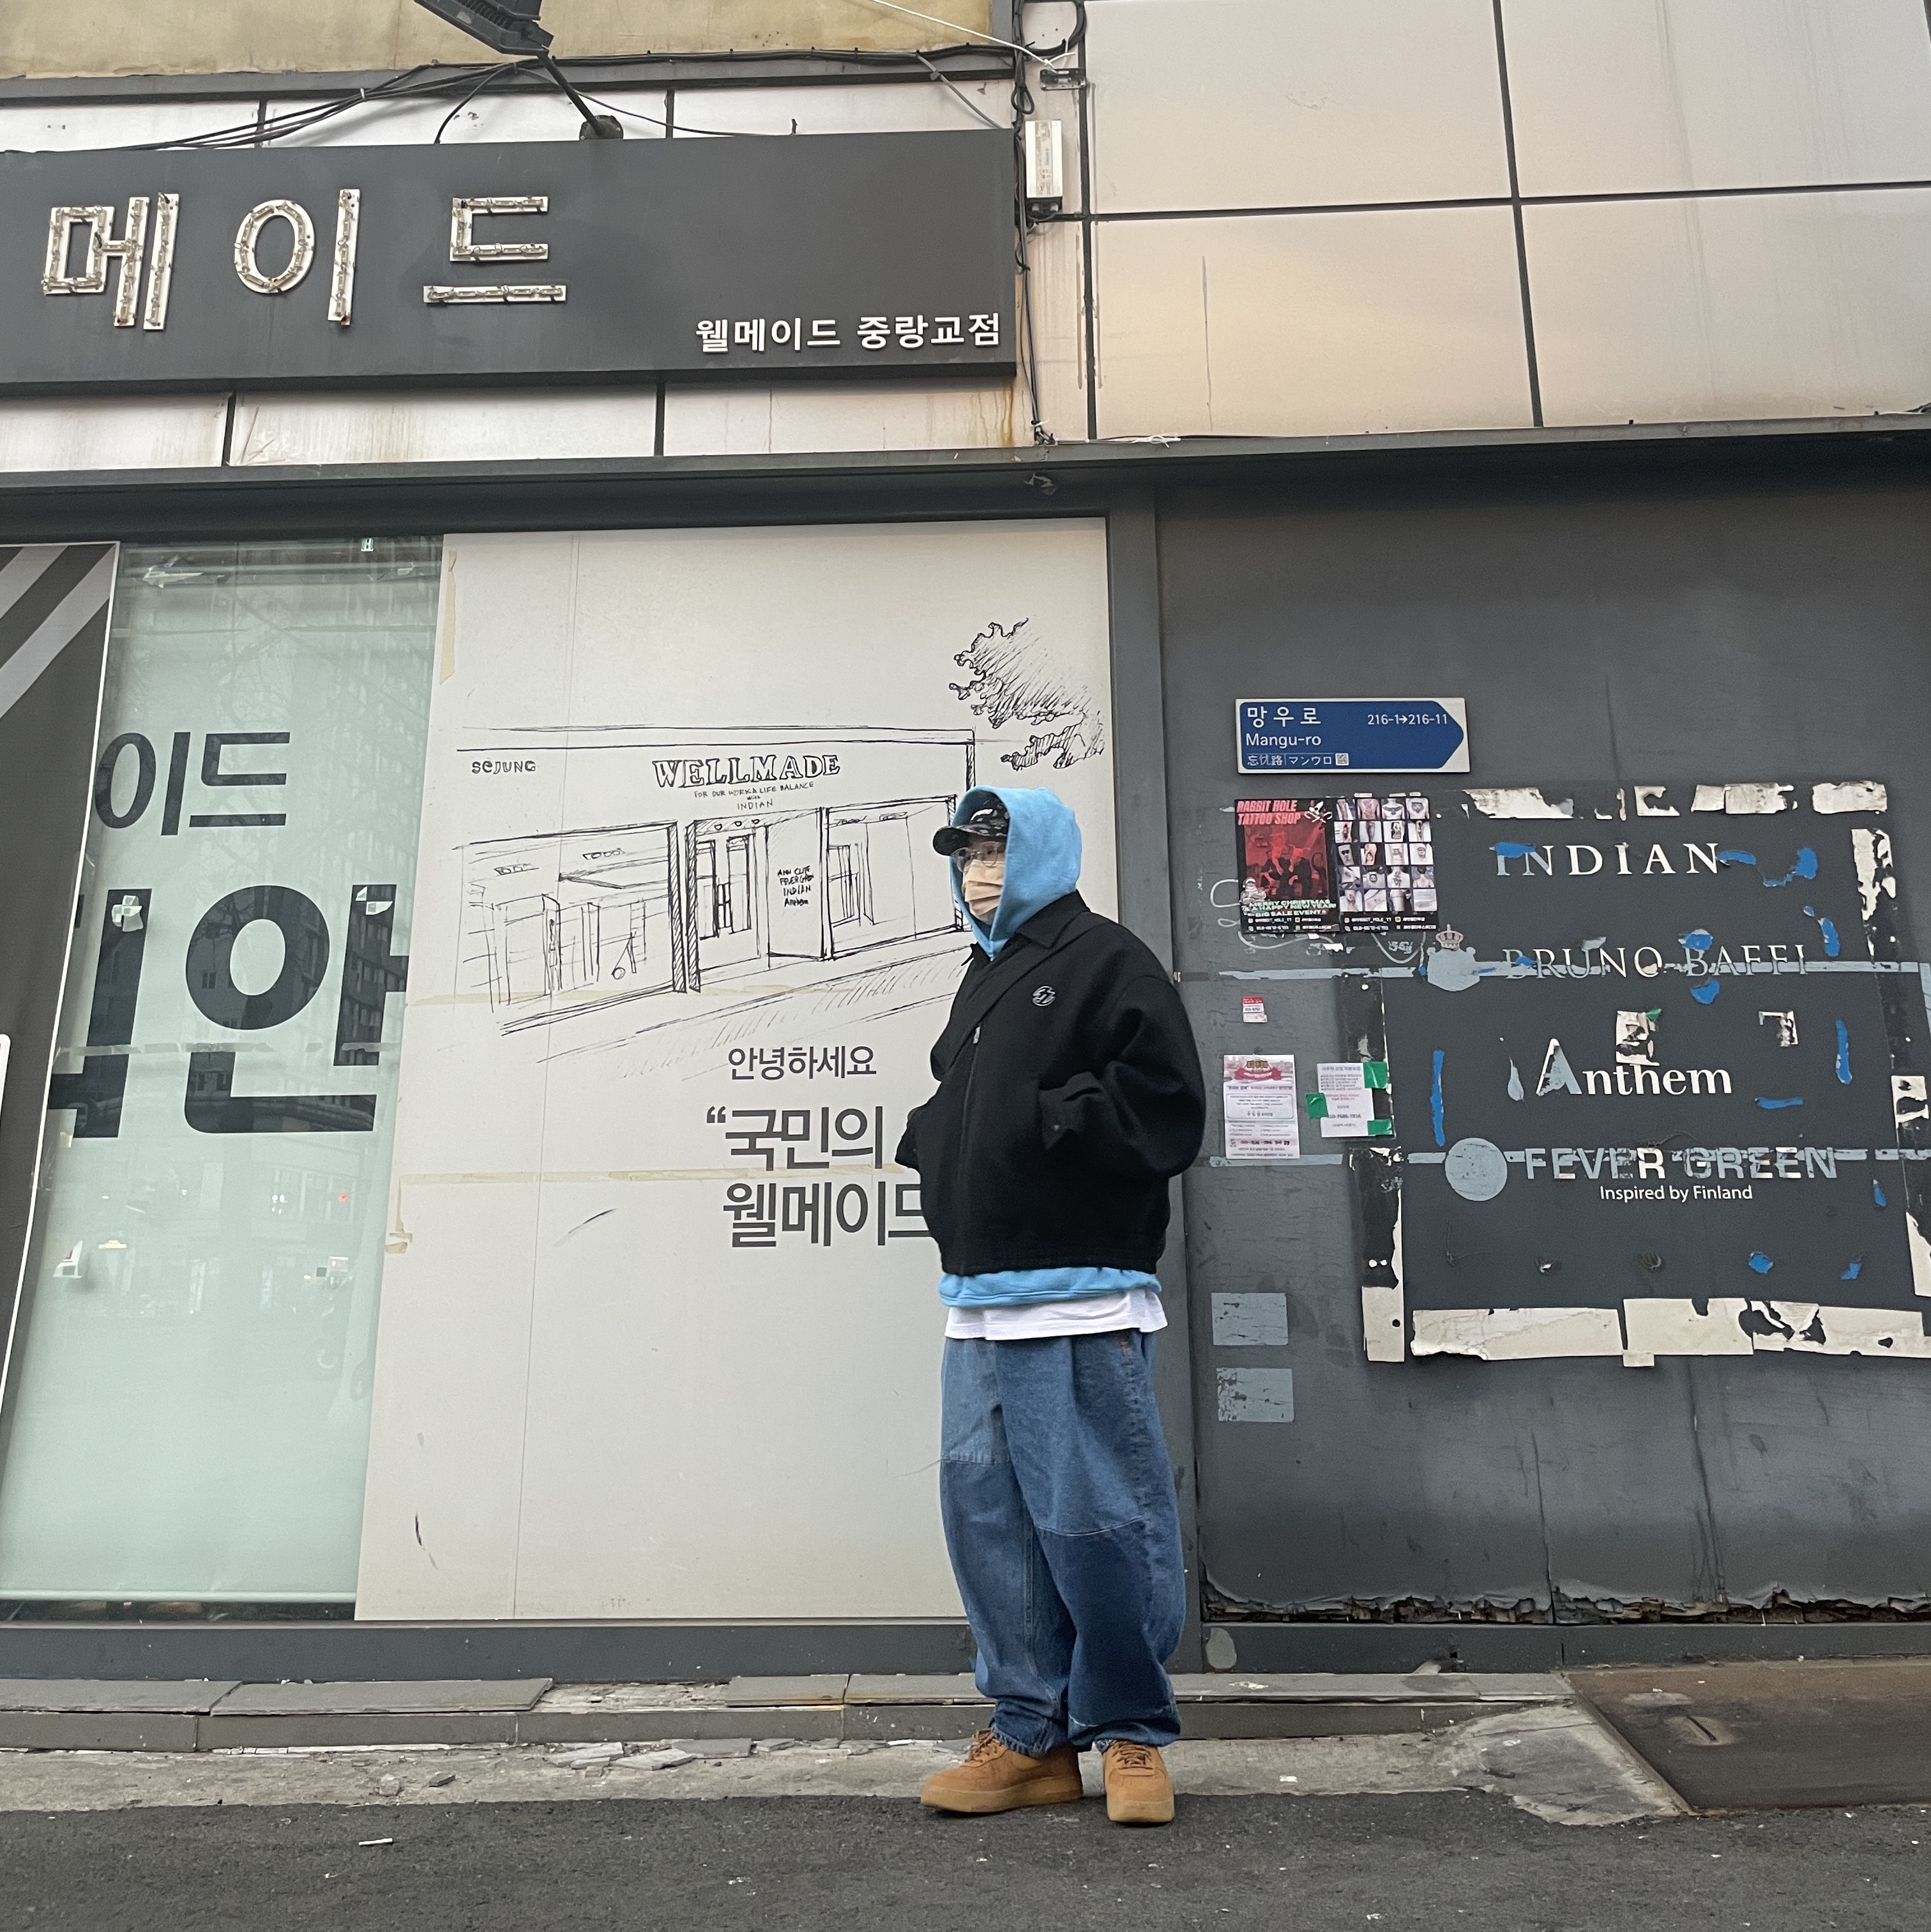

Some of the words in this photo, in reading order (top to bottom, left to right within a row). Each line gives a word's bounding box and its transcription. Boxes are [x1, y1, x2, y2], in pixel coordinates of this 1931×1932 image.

[43, 189, 567, 331] 메이드
[695, 317, 841, 353] 웰메이드
[857, 312, 1001, 350] 중랑교점
[1247, 706, 1321, 728] 망우로
[1246, 733, 1322, 749] Mangu-ro
[652, 754, 842, 788] WELLMADE
[694, 790, 708, 798] FOR
[712, 789, 726, 797] OUR
[759, 786, 777, 794] LIFE
[780, 780, 815, 792] BALANCE
[737, 798, 773, 810] INDIAN
[1237, 800, 1271, 813] RABBIT
[1272, 799, 1298, 812] HOLE
[1238, 812, 1273, 826] TATTOO
[1274, 812, 1301, 825] SHOP
[1495, 842, 1718, 876] INDIAN
[1502, 946, 1662, 979] BRUNO
[1685, 944, 1809, 977] BAFFI
[728, 1046, 877, 1081] 안녕하세요
[1536, 1038, 1732, 1097] Anthem
[1525, 1146, 1666, 1180] FEVER
[1683, 1146, 1838, 1180] GREEN
[1600, 1185, 1665, 1203] Inspired
[1669, 1185, 1688, 1203] by
[1693, 1184, 1753, 1200] Finland
